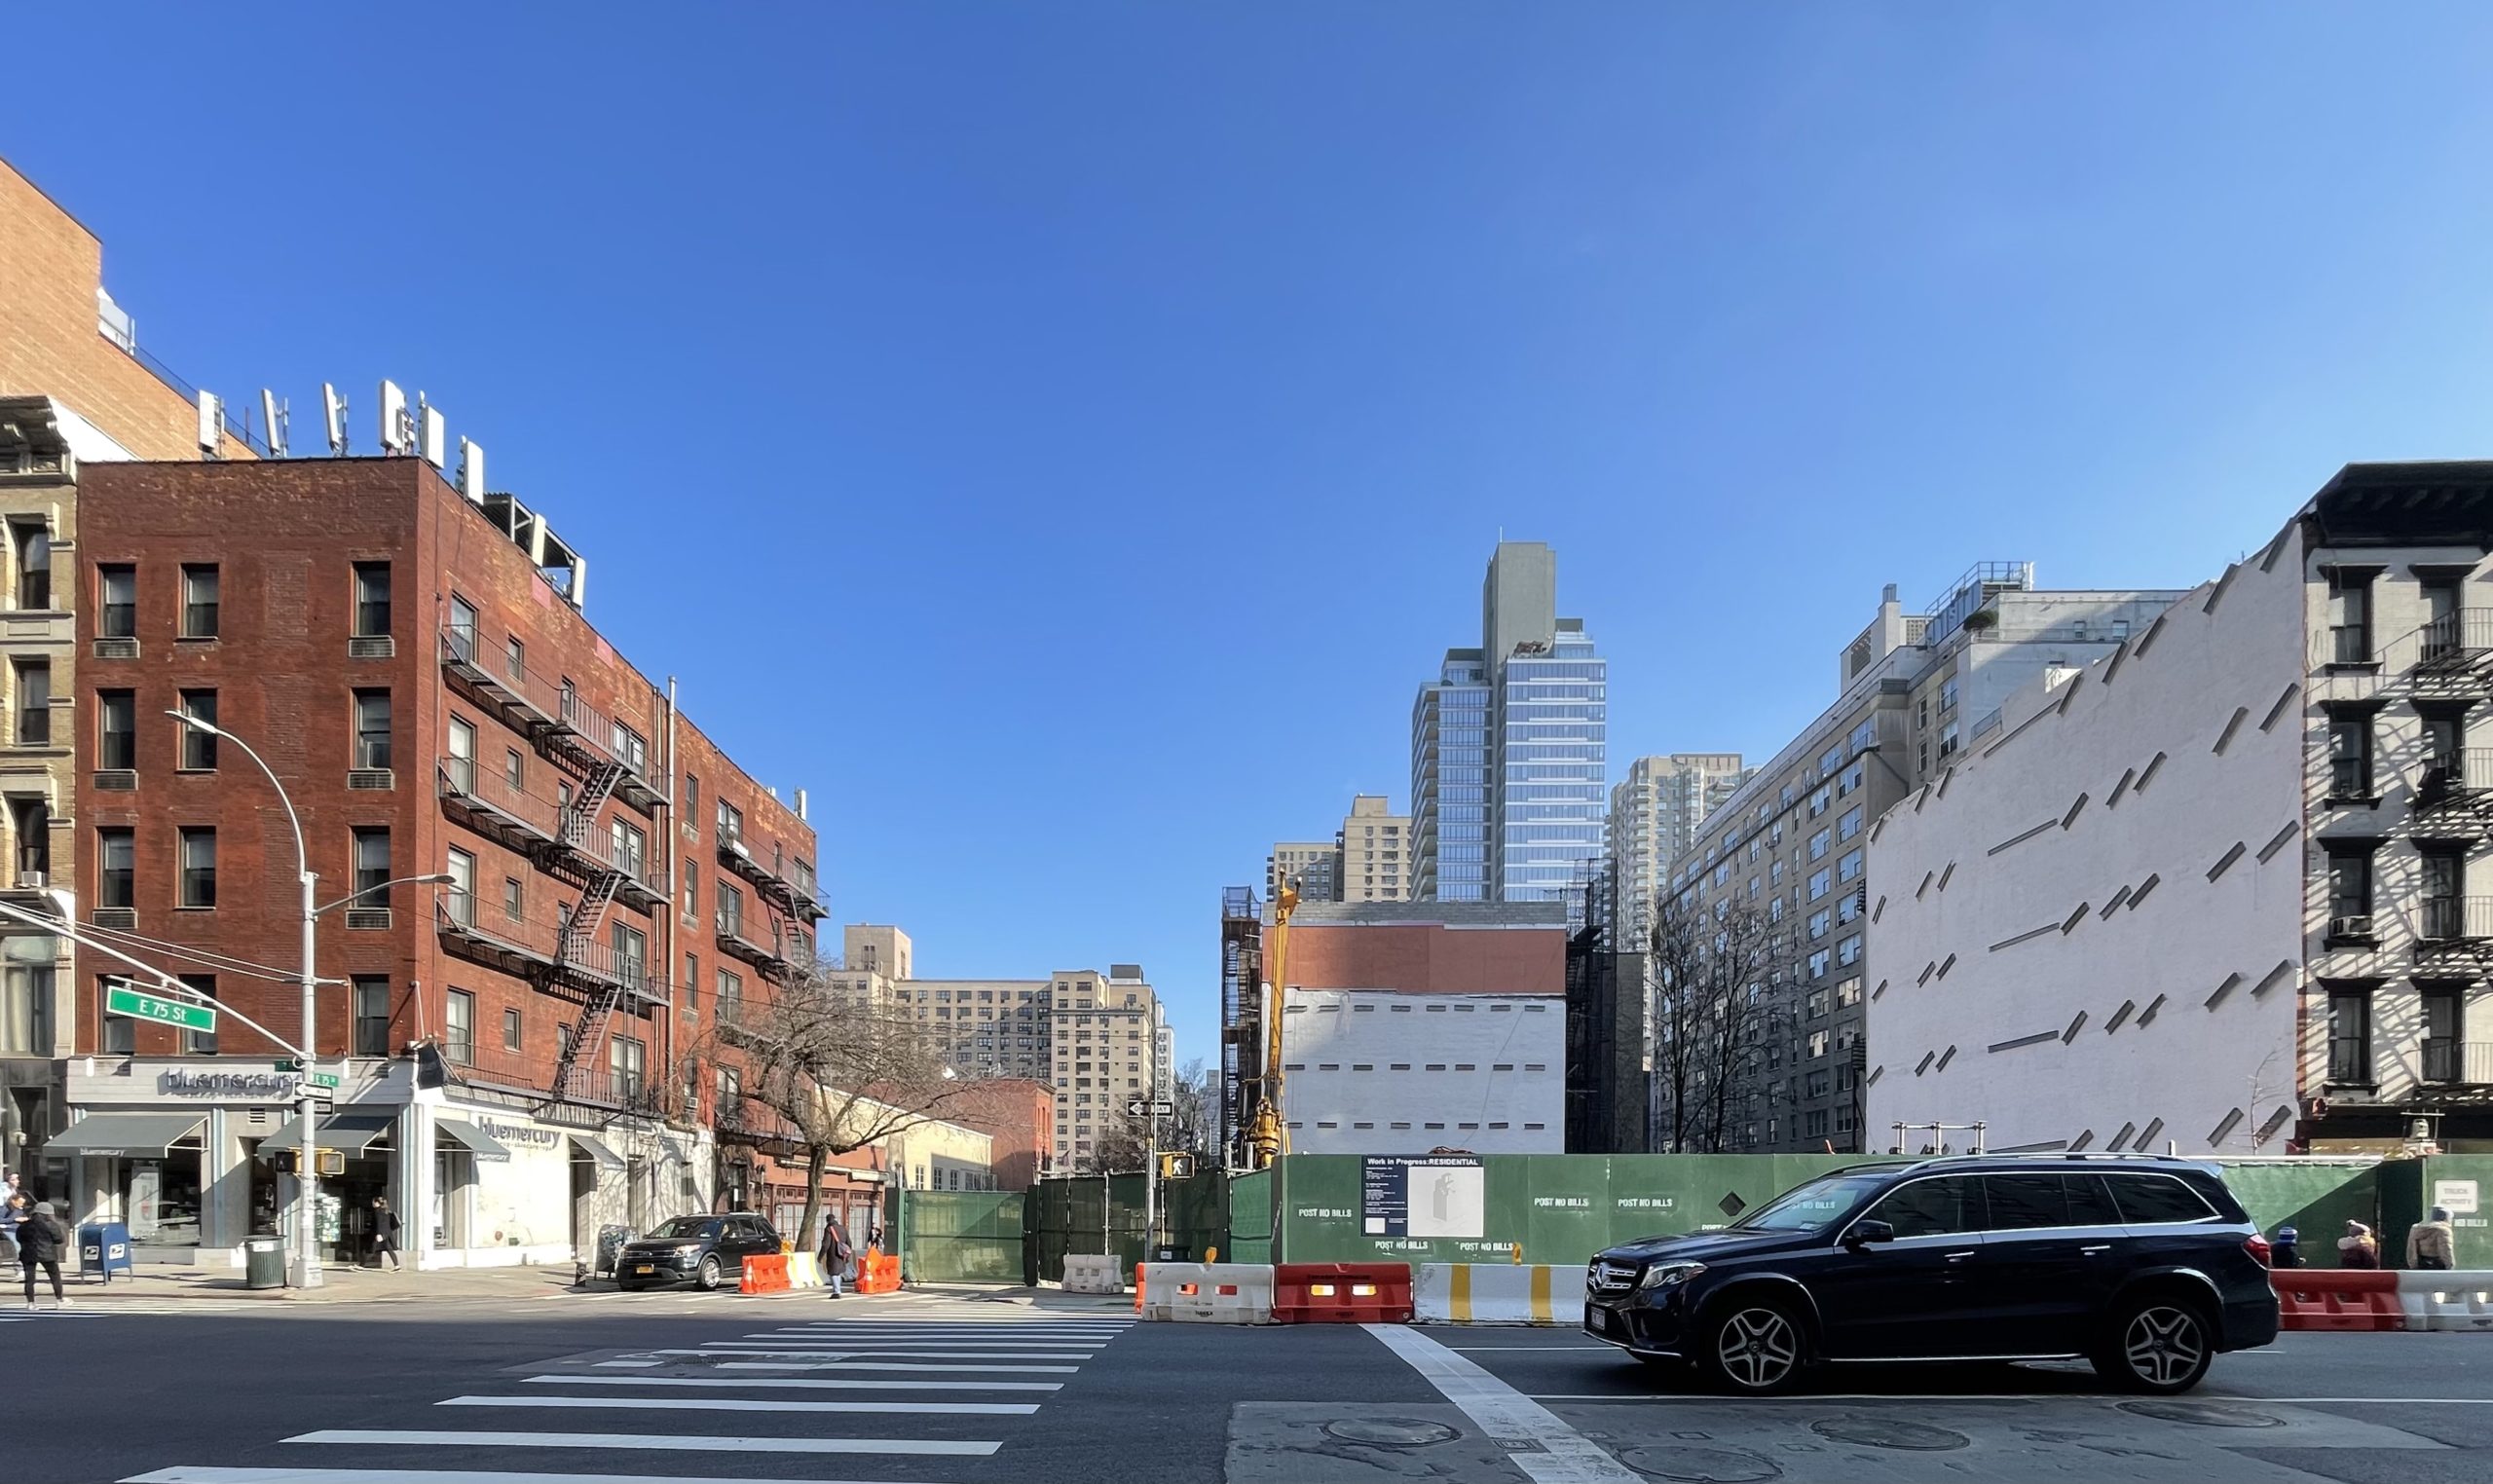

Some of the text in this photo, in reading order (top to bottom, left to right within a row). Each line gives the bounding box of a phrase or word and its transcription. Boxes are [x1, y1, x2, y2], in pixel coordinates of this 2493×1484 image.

[139, 999, 187, 1022] E 75 St
[478, 1116, 561, 1149] bluemercury
[1534, 1198, 1589, 1206] POST NO BILLS
[1298, 1208, 1318, 1217] POST
[1320, 1208, 1330, 1217] NO
[1375, 1241, 1394, 1249] POST
[1395, 1241, 1406, 1249] NO
[1460, 1243, 1513, 1251] POST NO BILLS
